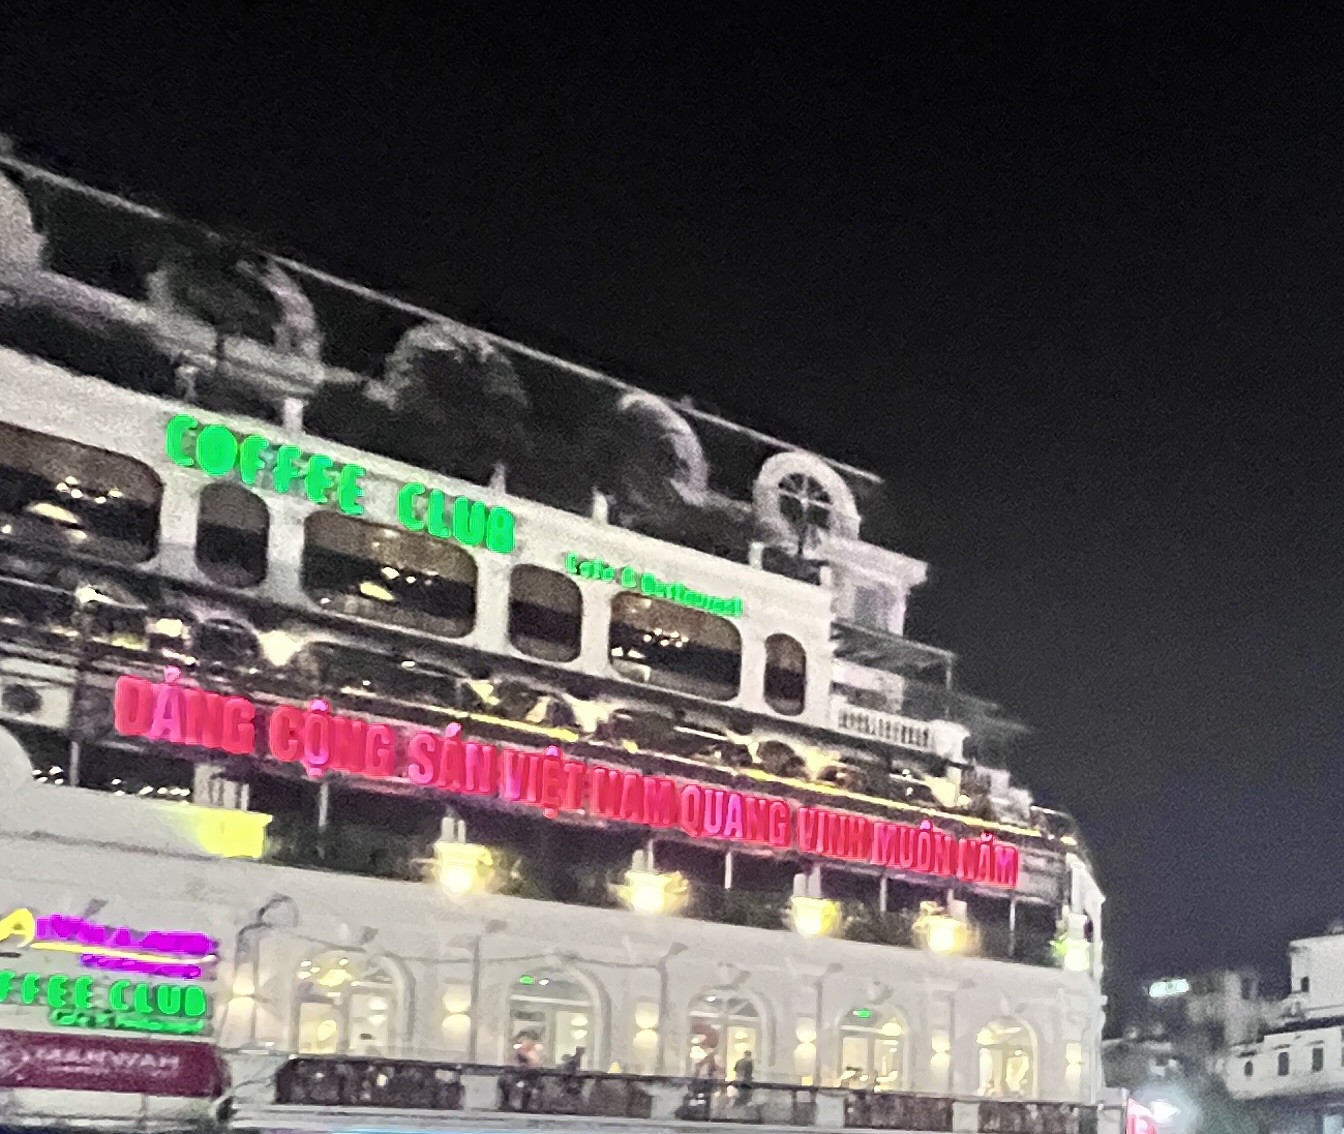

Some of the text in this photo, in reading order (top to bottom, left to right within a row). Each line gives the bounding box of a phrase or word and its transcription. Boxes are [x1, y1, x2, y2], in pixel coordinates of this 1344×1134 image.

[165, 413, 516, 555] COFFEE CLUB
[681, 783, 792, 847] QUANG
[798, 806, 869, 864] VINH
